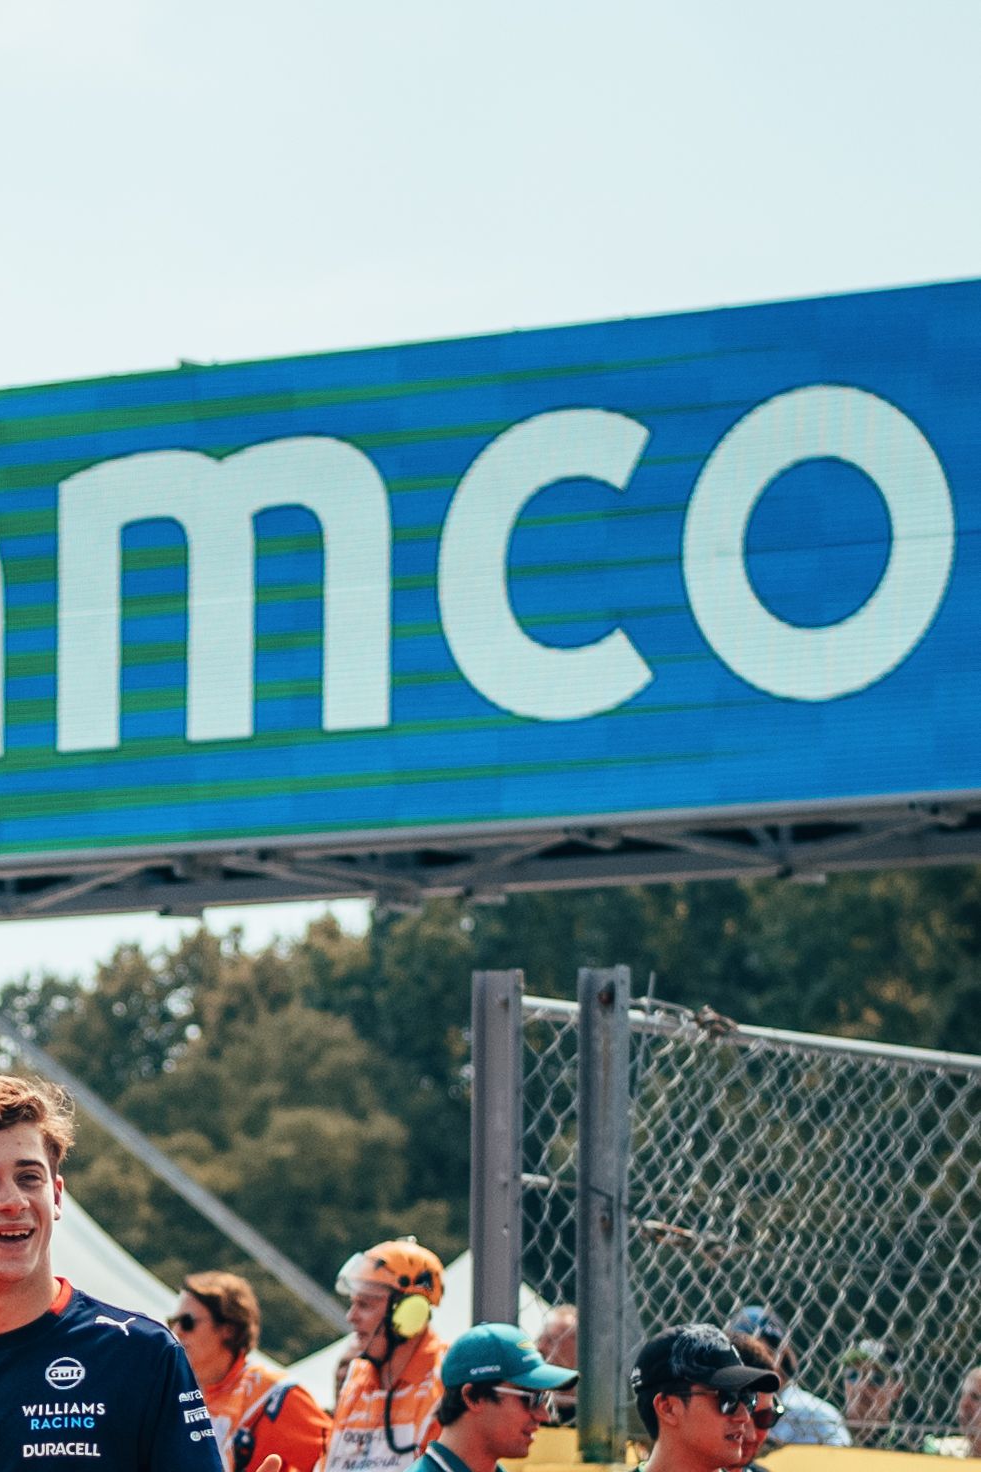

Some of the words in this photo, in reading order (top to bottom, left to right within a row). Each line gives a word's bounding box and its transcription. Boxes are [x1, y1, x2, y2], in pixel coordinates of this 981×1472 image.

[49, 1368, 82, 1379] Gulf
[22, 1402, 106, 1416] WILLIAMS
[31, 1417, 95, 1430] RACING
[23, 1442, 101, 1458] DURACELL
